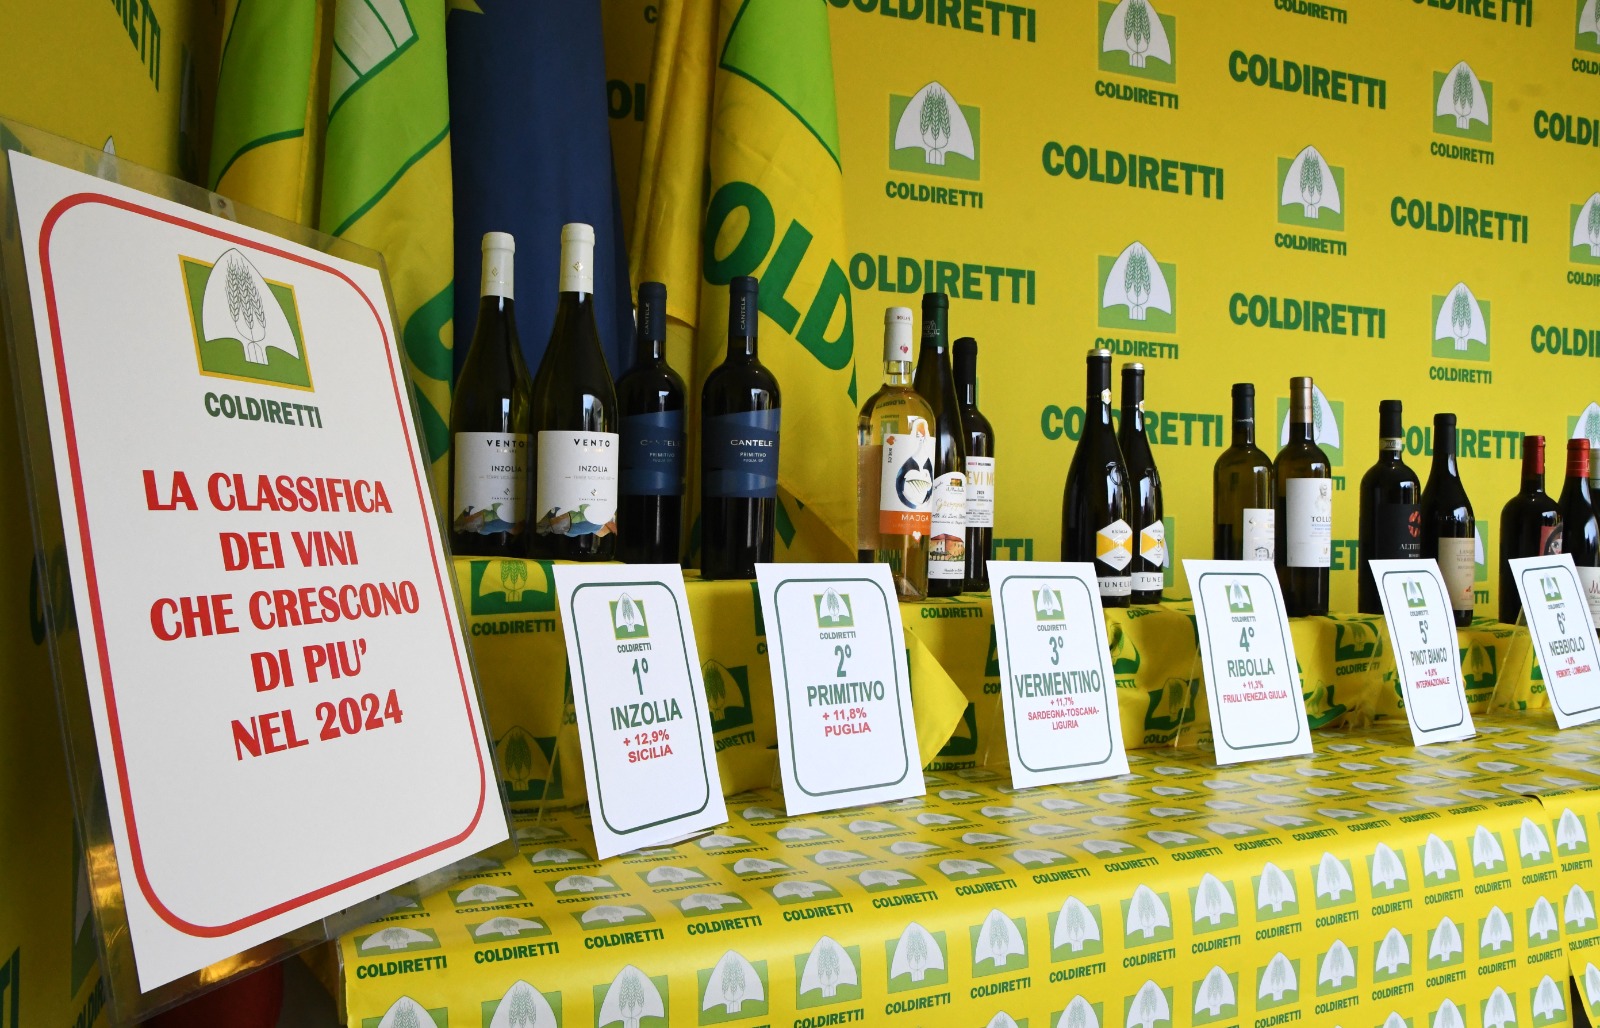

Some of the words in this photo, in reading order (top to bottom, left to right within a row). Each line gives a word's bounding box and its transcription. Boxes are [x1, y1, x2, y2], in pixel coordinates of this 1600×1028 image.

[1229, 50, 1386, 110] COLDIRETTI
[1095, 80, 1179, 110] COLDIRETTI
[1430, 142, 1494, 165] COLDIRETTI
[1042, 141, 1224, 200] COLDIRETTI
[885, 180, 983, 209] COLDIRETTI
[1391, 196, 1528, 243] COLDIRETTI
[1275, 233, 1347, 256] COLDIRETTI
[849, 252, 1036, 305] OLDIRETTI
[1229, 293, 1386, 338] COLDIRETTI
[1429, 366, 1492, 384] COLDIRETTI
[204, 392, 322, 429] COLDIRETTI
[1041, 404, 1223, 447] CORETTI
[486, 440, 525, 448] VENTO
[573, 439, 611, 447] VENTO
[730, 439, 773, 447] CANTELE
[491, 465, 523, 473] INZOLIA
[578, 465, 609, 473] INZOLIA
[142, 470, 198, 511] LA
[207, 472, 393, 513] CLASSIFICA
[219, 532, 285, 571] DEI
[292, 531, 358, 567] VINI
[150, 594, 239, 641] CHE
[248, 581, 420, 630] CRESCONO
[921, 607, 983, 619] COLDIRETTI
[471, 619, 556, 636] COLDIRETTI
[819, 630, 856, 640] COLDIRETTI
[1036, 624, 1067, 632] COLDIRETTI
[617, 642, 652, 653] COLDIRETTI
[1548, 636, 1585, 656] NEBBIOLO
[1409, 649, 1428, 666] PINOT
[1428, 647, 1448, 665] BIANCO
[250, 651, 294, 692] DI
[1227, 657, 1275, 678] RIBOLLA
[1014, 669, 1101, 698] VERMENTINO
[1248, 680, 1264, 690] 11,3%
[806, 680, 885, 707] PRIMITIVO
[1056, 697, 1074, 706] 11,7%
[1223, 694, 1243, 704] FRIULI
[1243, 692, 1268, 702] VENEZIA
[1268, 691, 1288, 701] GIULIA
[610, 698, 683, 731] INZOLIA
[833, 707, 867, 721] 11,8%
[1027, 709, 1100, 721] SARDEGNA-TOSCANA-
[231, 711, 309, 761] NEL
[315, 689, 403, 740] 2024
[824, 722, 872, 737] PUGLIA
[1052, 720, 1079, 731] LIGURIA
[623, 737, 631, 747] +
[634, 729, 670, 747] 12,9%
[627, 744, 673, 763] SICILIA
[1292, 828, 1338, 841] COLDIRETTI
[1233, 837, 1283, 851] COLDIRETTI
[1171, 847, 1223, 862] COLDIRETTI
[1104, 857, 1159, 873] COLDIRETTI
[1032, 867, 1091, 885] COLDIRETTI
[1521, 870, 1558, 885] COLDIRETTI
[652, 882, 722, 893] COLDIRETTI
[955, 879, 1017, 897] COLDIRETTI
[1474, 879, 1512, 894] COLDIRETTI
[557, 892, 631, 904] COLDIRETTI
[872, 891, 938, 909] COLDIRETTI
[1424, 889, 1464, 905] COLDIRETTI
[455, 902, 535, 914] COLDIRETTI
[783, 903, 854, 922] COLDIRETTI
[1371, 899, 1413, 916] COLDIRETTI
[687, 915, 762, 935] COLDIRETTI
[1315, 910, 1359, 928] COLDIRETTI
[584, 928, 664, 950] COLDIRETTI
[1255, 922, 1302, 940] COLDIRETTI
[474, 942, 559, 964] COLDIRETTI
[1191, 935, 1241, 954] COLDIRETTI
[1122, 948, 1176, 968] COLDIRETTI
[1527, 948, 1563, 964] COLDIRETTI
[356, 955, 448, 980] COLDIRETTI
[1049, 962, 1106, 983] COLDIRETTI
[1478, 959, 1516, 975] COLDIRETTI
[970, 976, 1031, 999] COLDIRETTI
[1425, 970, 1466, 987] COLDIRETTI
[1371, 983, 1414, 1001] COLDIRETTI
[885, 992, 951, 1015] COLDIRETTI
[1315, 996, 1359, 1015] COLDIRETTI
[793, 1008, 864, 1028] COLDIRETTI
[1254, 1009, 1301, 1028] COLDIRETTI
